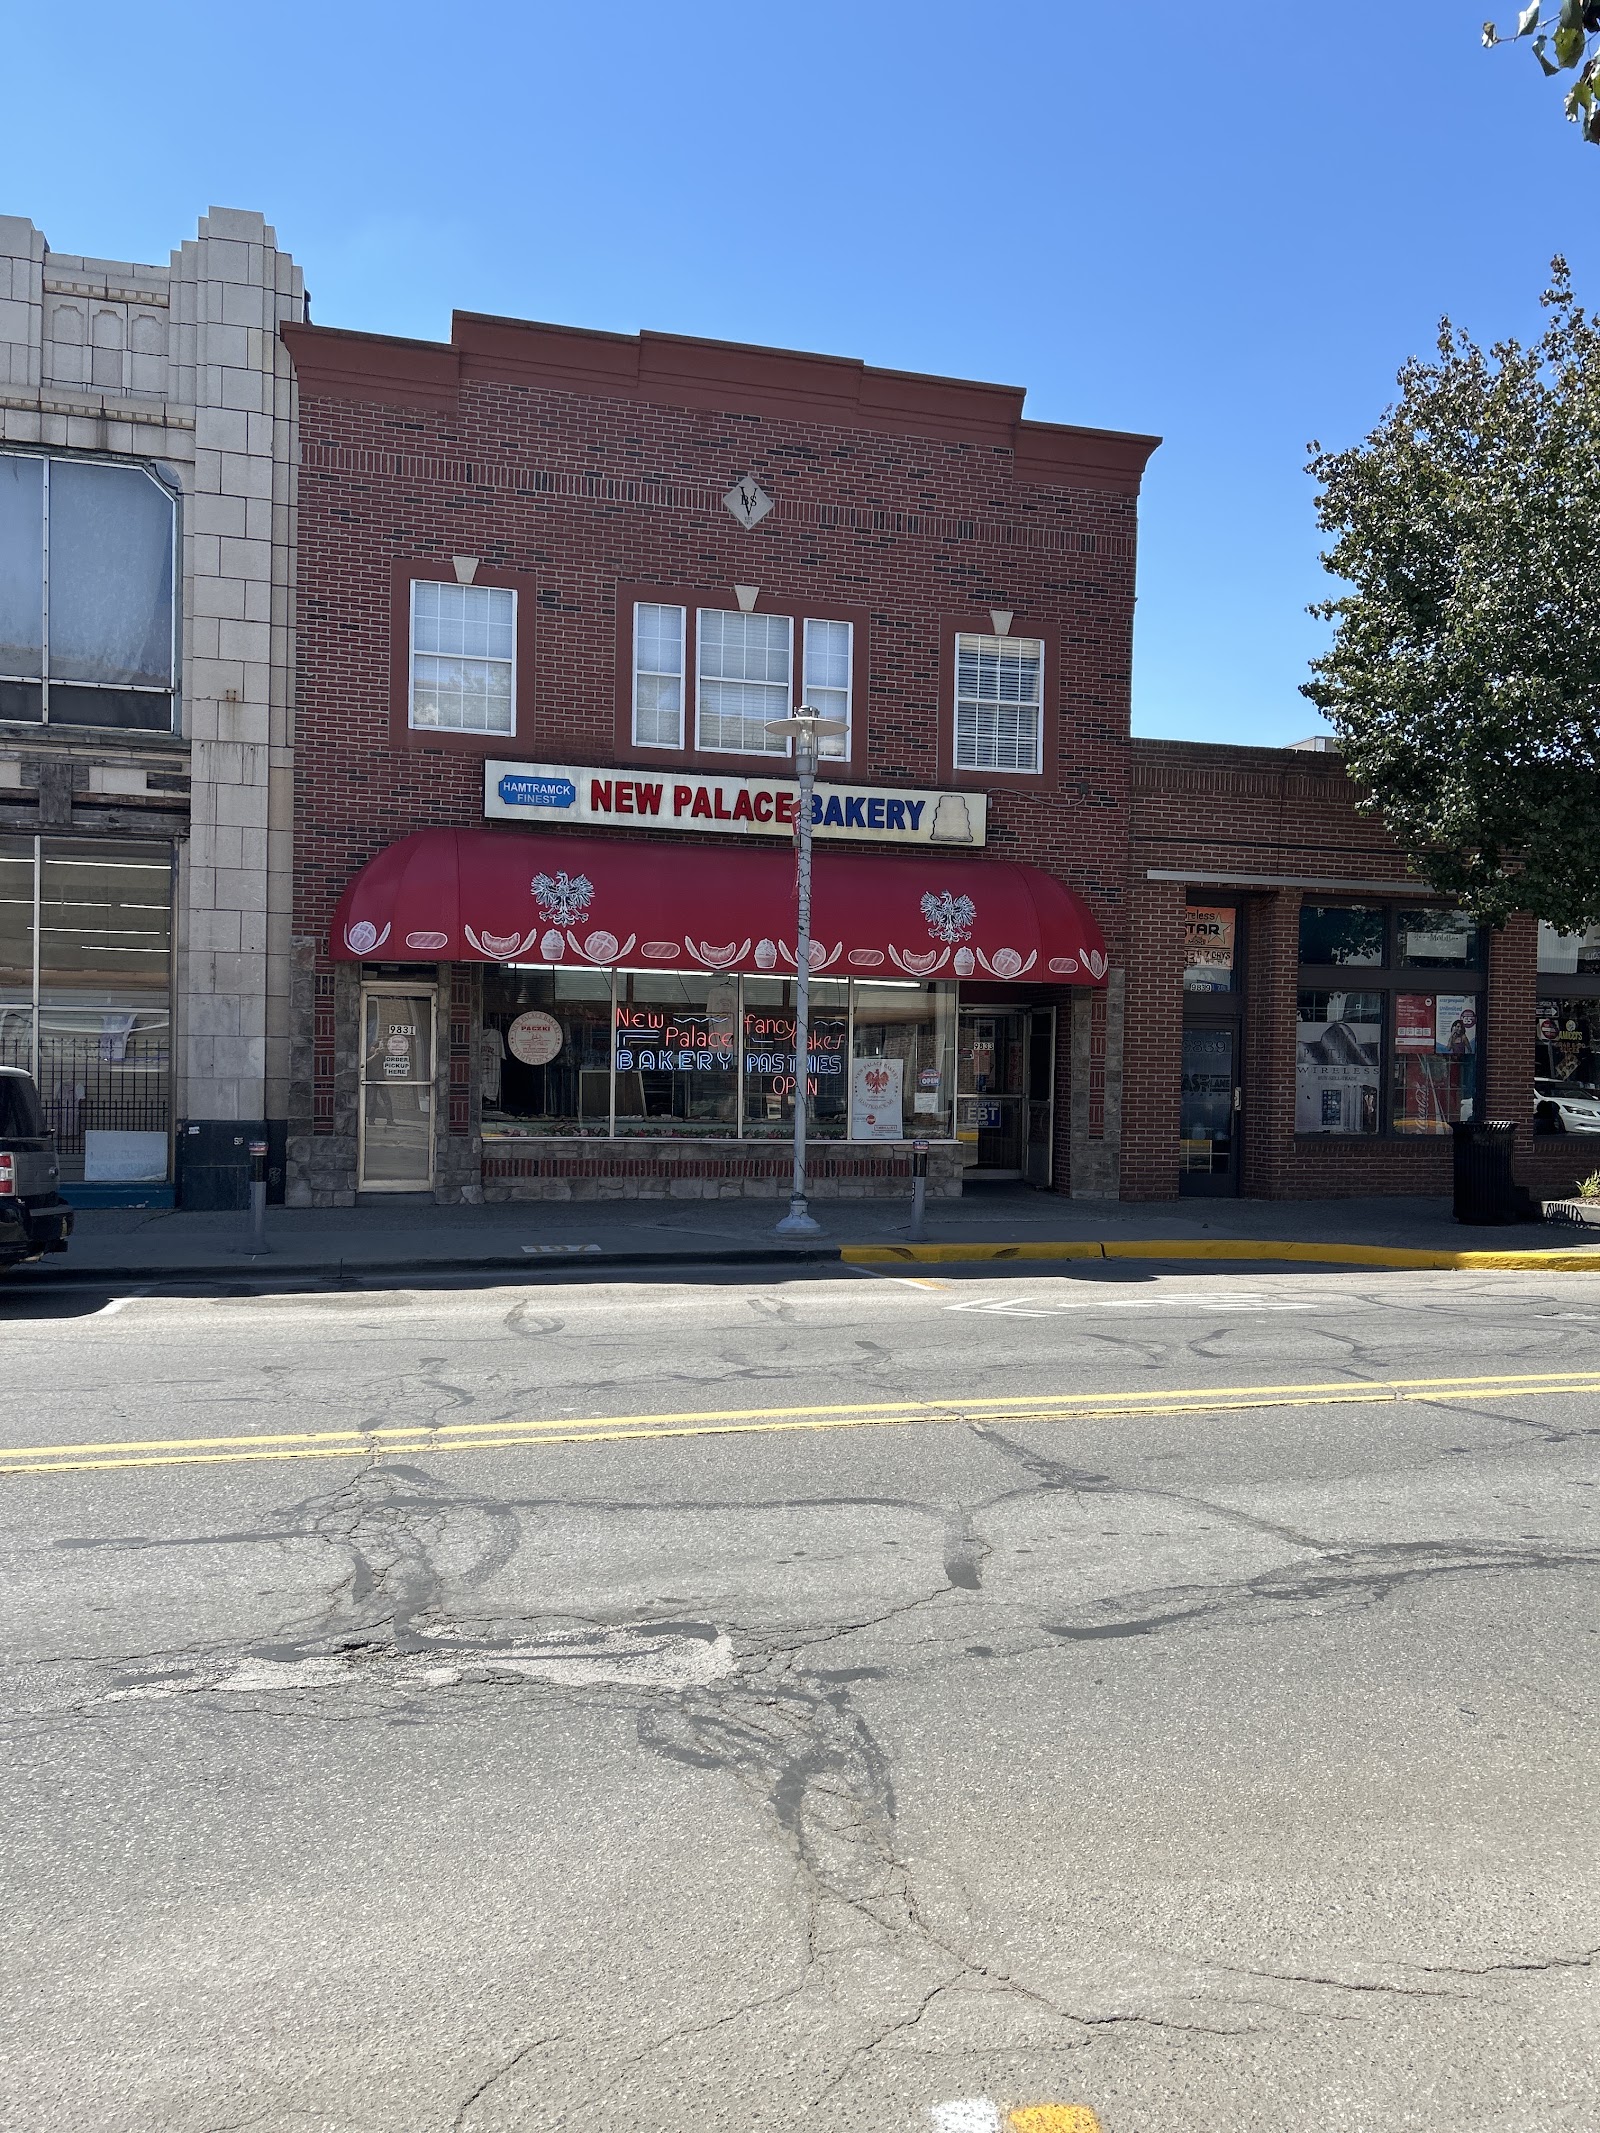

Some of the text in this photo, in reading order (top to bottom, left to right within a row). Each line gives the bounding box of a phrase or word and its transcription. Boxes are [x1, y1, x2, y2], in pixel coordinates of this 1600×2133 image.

[503, 781, 571, 796] HAMTRAMCK
[517, 793, 557, 805] FINEST
[591, 779, 664, 816] NEW
[673, 785, 794, 824] PALACE
[809, 794, 926, 831] BAKERY
[1185, 909, 1215, 920] ireless
[1185, 922, 1220, 935] TAR
[615, 1007, 664, 1029] New
[390, 1025, 414, 1034] 9831
[665, 1025, 734, 1048] Palace
[616, 1050, 842, 1075] BAKERY PASTIES
[863, 1061, 883, 1070] PALACE
[884, 1063, 899, 1079] BAKERY
[1297, 1066, 1380, 1075] WIRELESS
[772, 1075, 818, 1096] OPN
[921, 1077, 939, 1085] OPEN
[1181, 1073, 1230, 1092] AST LANE
[967, 1107, 999, 1121] EBT
